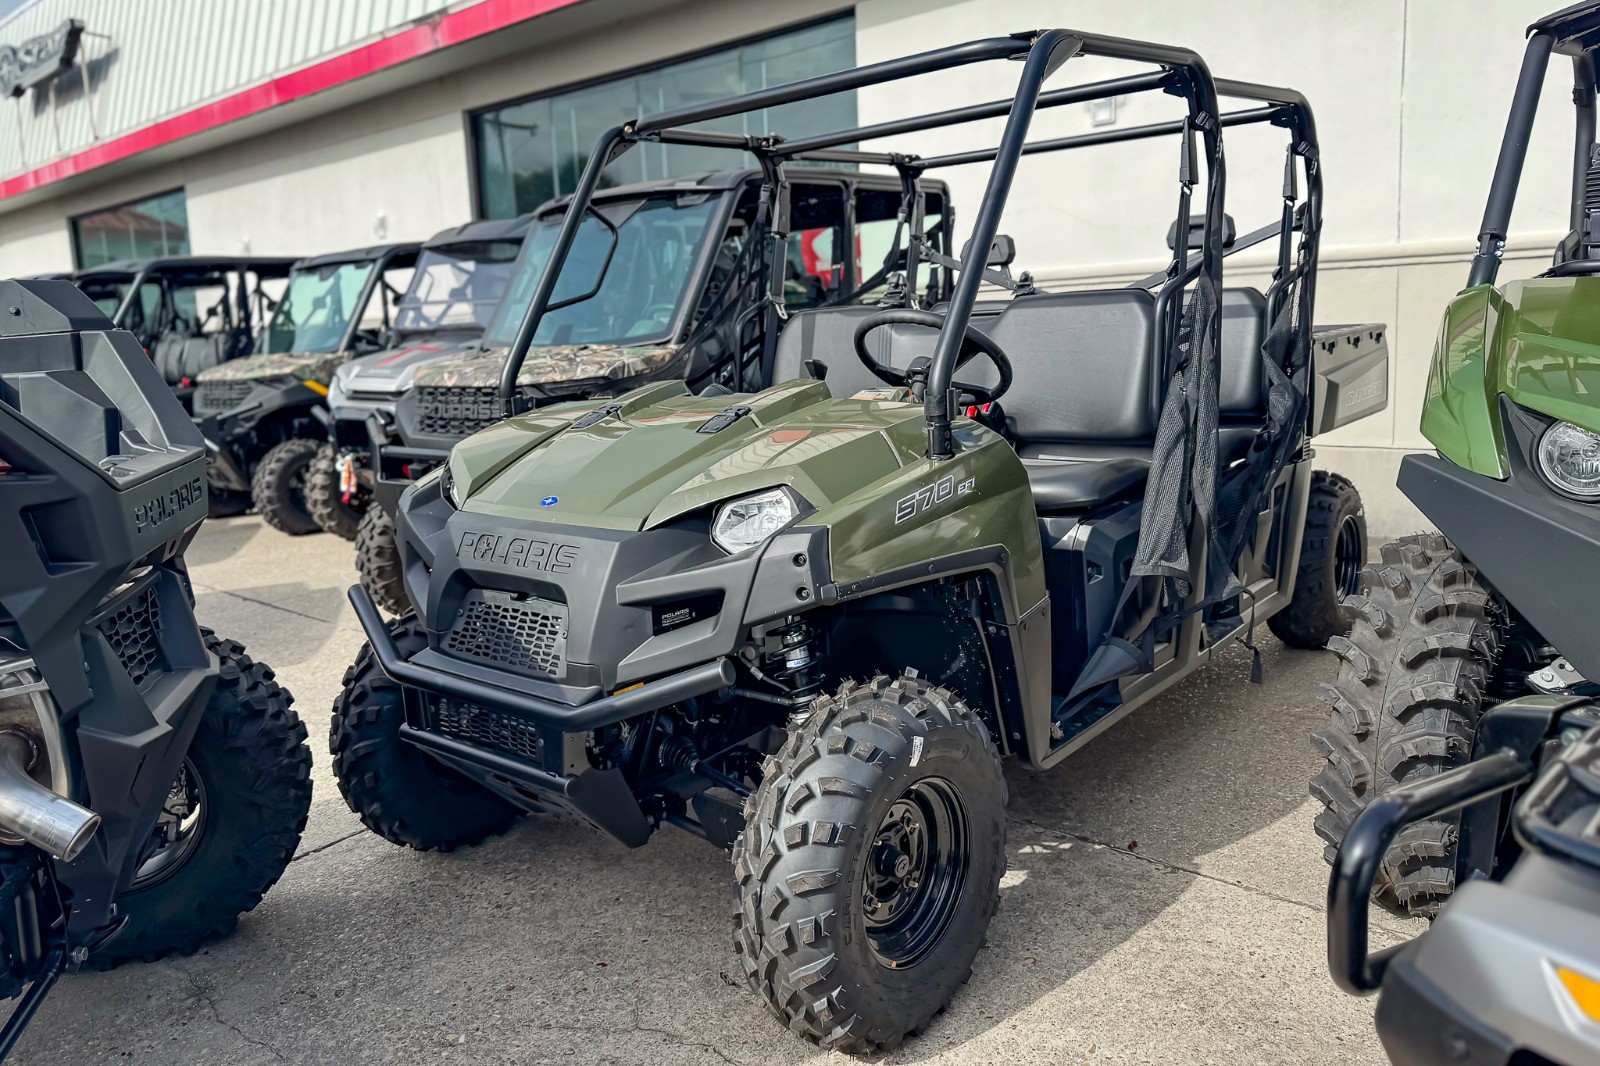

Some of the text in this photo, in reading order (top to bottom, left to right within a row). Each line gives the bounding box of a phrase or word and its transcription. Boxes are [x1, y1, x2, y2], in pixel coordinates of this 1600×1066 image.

[421, 403, 491, 419] POLARIS
[134, 476, 203, 535] POLARIS
[895, 474, 975, 525] 570 EFI
[456, 531, 581, 574] POLARIS
